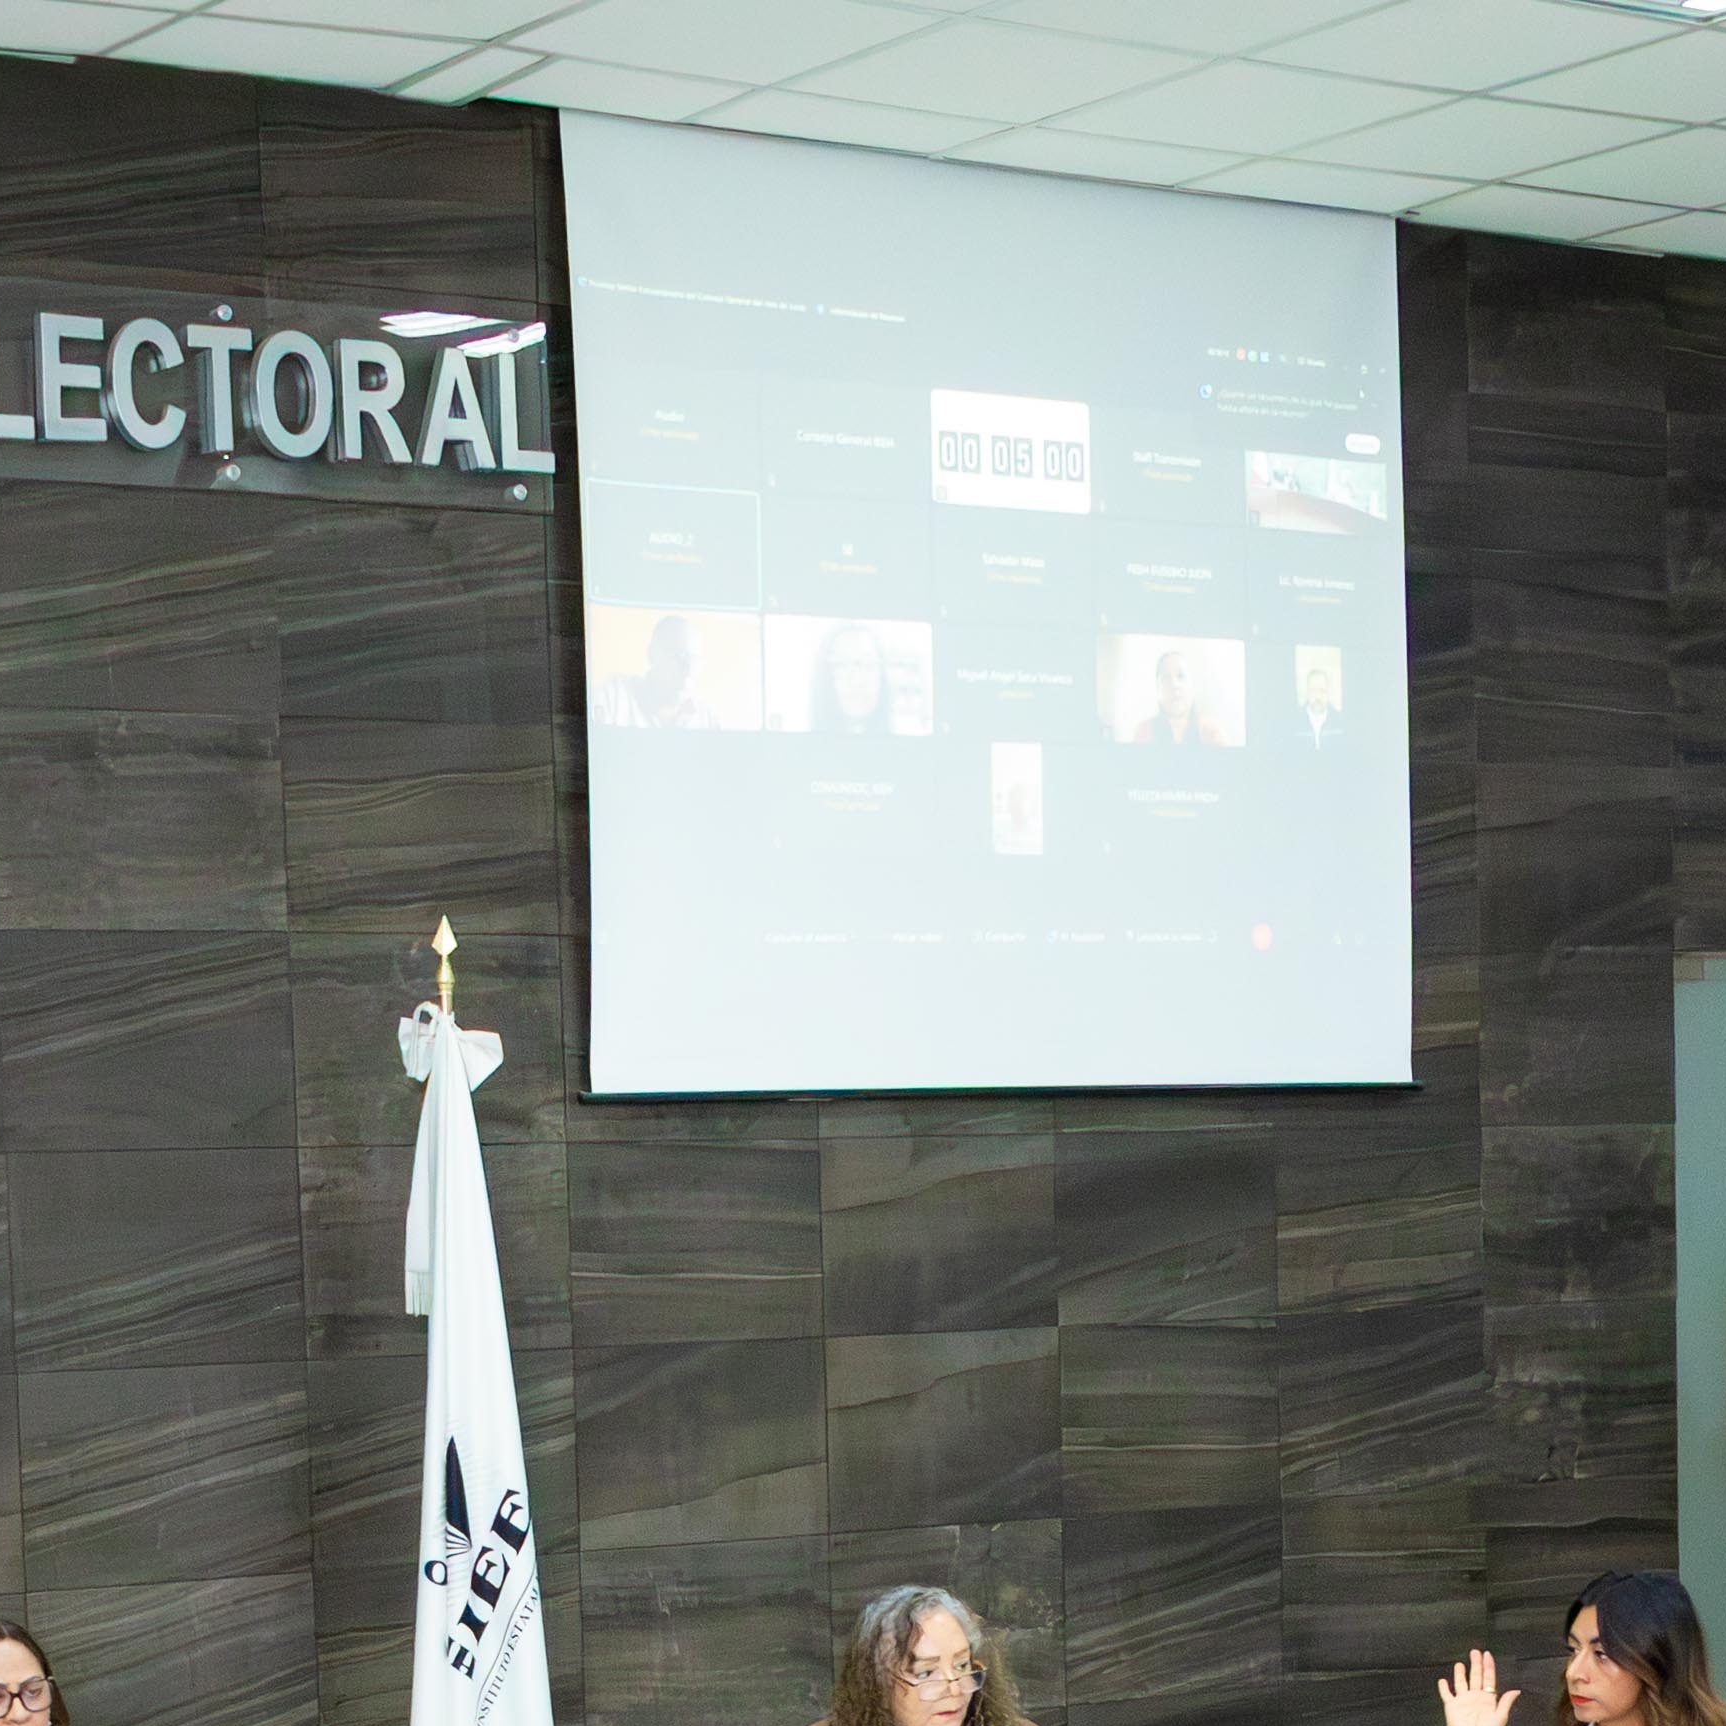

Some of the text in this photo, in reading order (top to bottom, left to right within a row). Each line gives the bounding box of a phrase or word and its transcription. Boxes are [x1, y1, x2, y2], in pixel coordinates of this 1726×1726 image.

[940, 434, 1083, 480] 00 05 00
